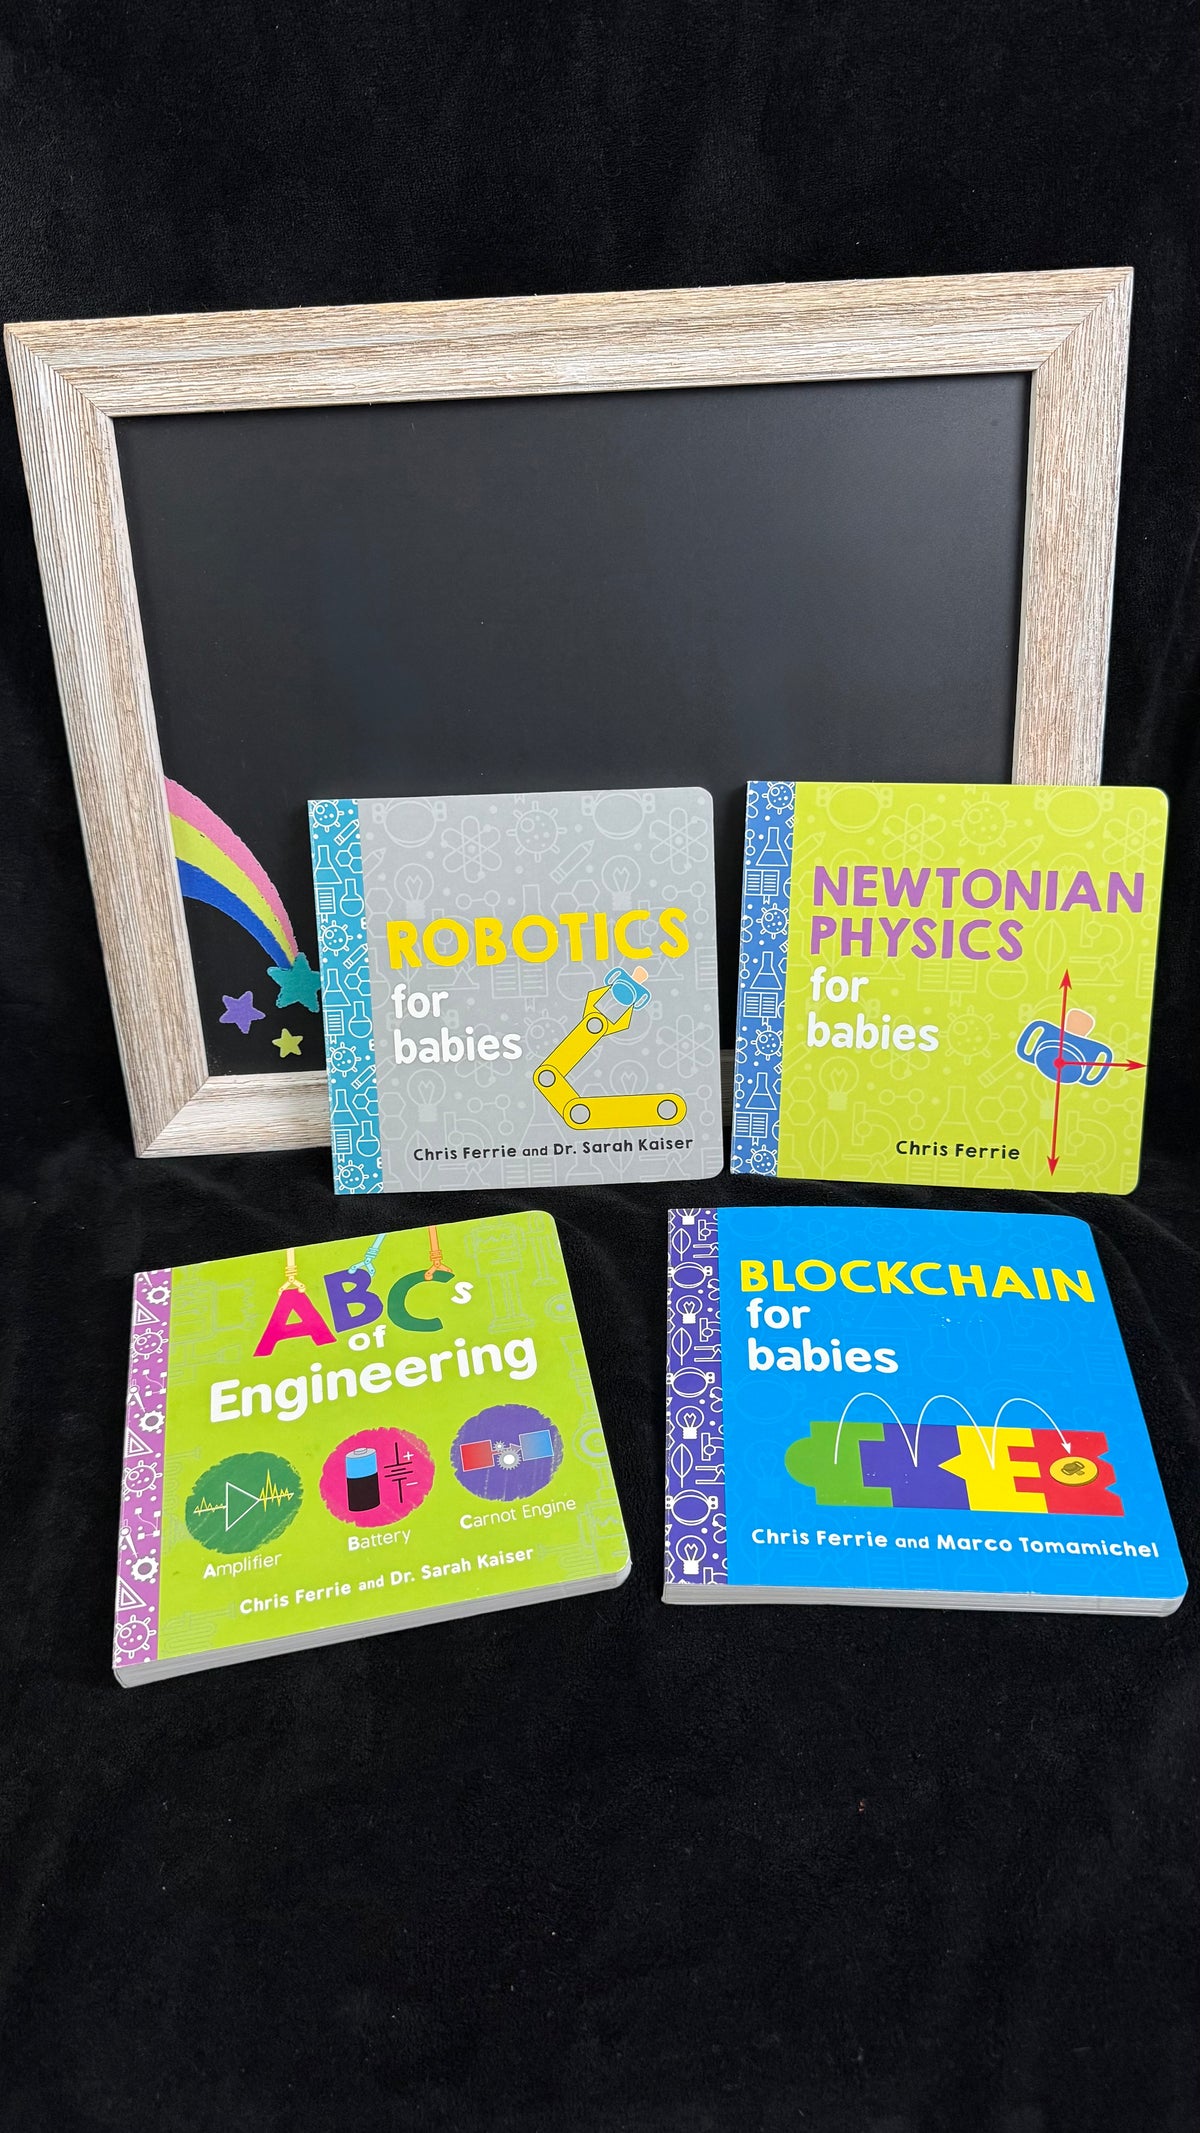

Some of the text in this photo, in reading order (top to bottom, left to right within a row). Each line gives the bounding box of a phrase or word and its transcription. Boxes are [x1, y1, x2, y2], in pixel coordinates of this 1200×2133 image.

[813, 866, 1144, 913] NEWTONIAN
[386, 908, 690, 969] ROBOTICS
[810, 916, 1023, 960] PHYSICS
[391, 984, 448, 1018] for
[810, 966, 868, 1002] for
[394, 1027, 522, 1064] babies
[807, 1011, 938, 1051] babies
[414, 1137, 693, 1161] Chris Ferrie and Dr. Sarah Kaiser
[896, 1140, 1020, 1160] Chris Ferrie
[739, 1259, 1095, 1302] BLOCKCHAIN
[746, 1298, 811, 1329] for
[348, 1324, 386, 1351] of
[748, 1338, 899, 1374] babies
[210, 1336, 538, 1422] Engineering
[459, 1498, 577, 1530] Carnot Engine
[347, 1528, 411, 1551] Battery
[751, 1529, 1159, 1558] Chris Ferrie and Marco Tomamichel
[203, 1552, 281, 1579] Amplifier
[239, 1546, 533, 1614] Chris Ferrie and Dr. Sarah Kaiser
